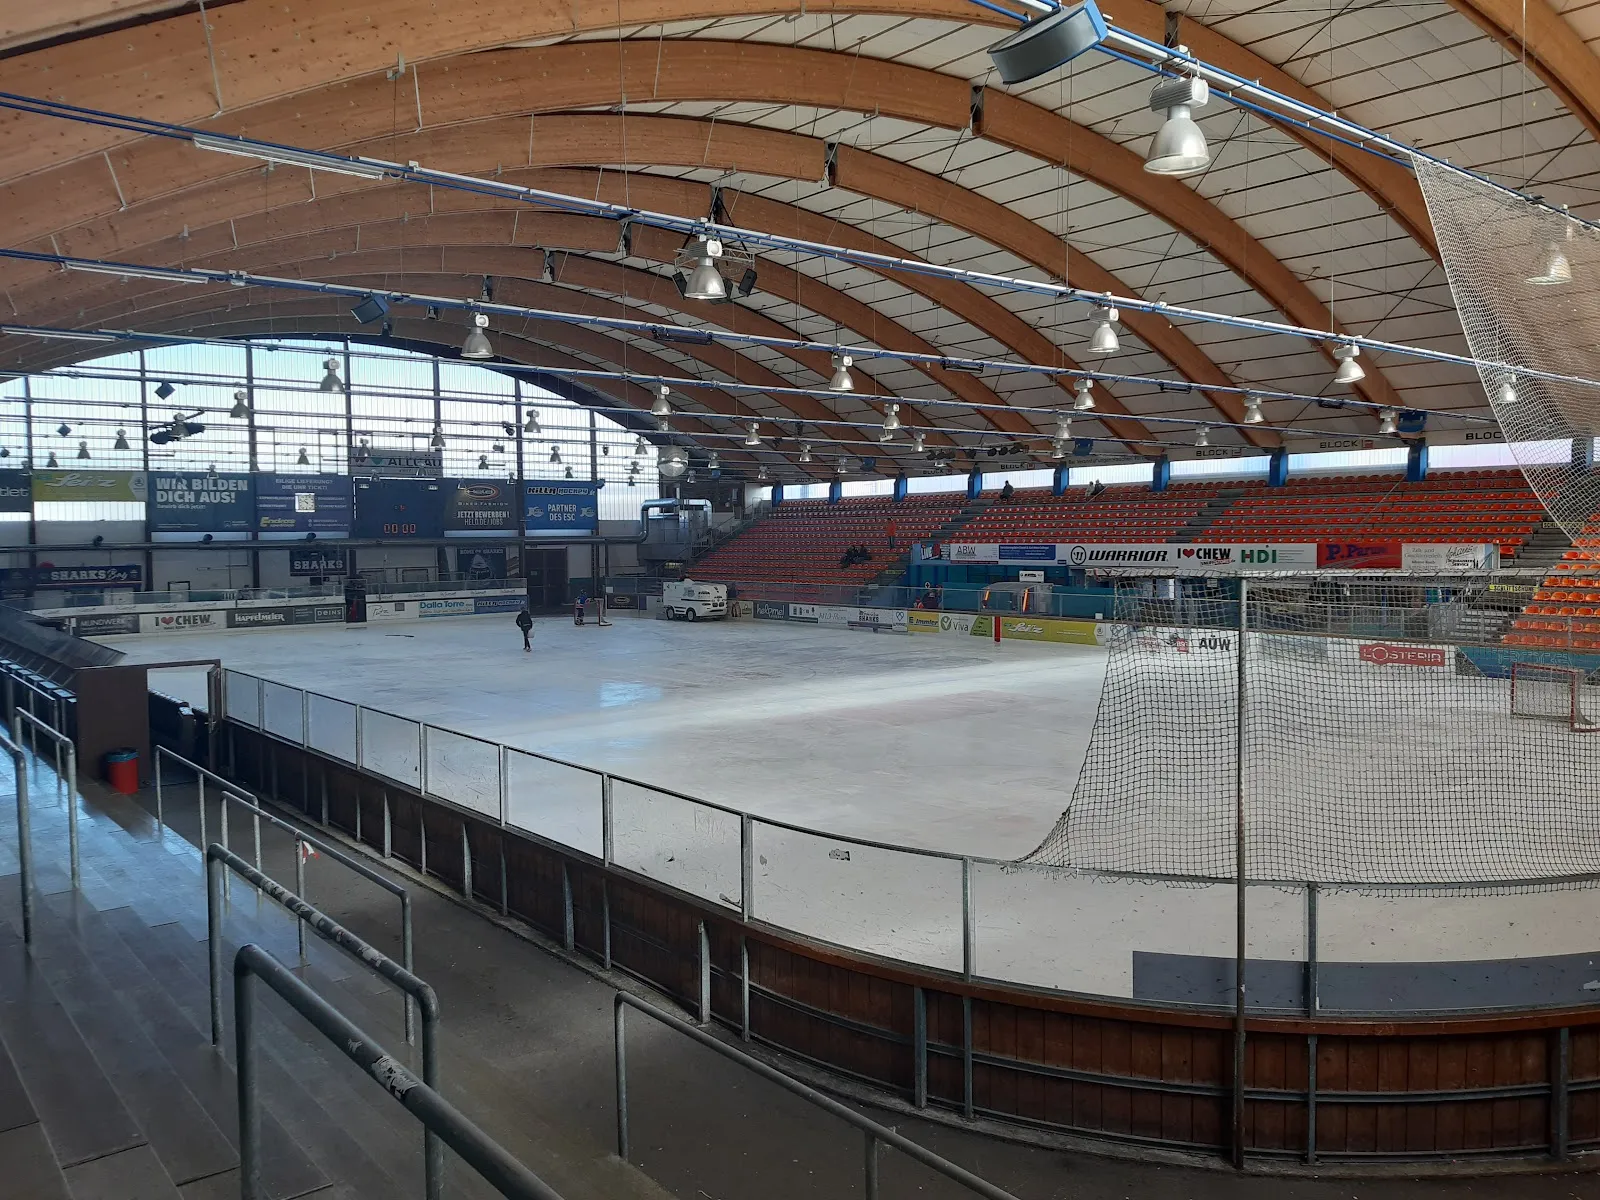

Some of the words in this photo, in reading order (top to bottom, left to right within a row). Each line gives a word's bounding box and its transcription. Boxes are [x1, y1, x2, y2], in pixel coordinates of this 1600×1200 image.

[1320, 440, 1358, 448] BLOCK
[156, 478, 188, 490] WIR
[192, 479, 248, 490] BILDEN
[156, 491, 195, 502] DICH
[199, 492, 236, 503] AUS!
[548, 504, 576, 512] PARTNER
[957, 546, 976, 554] ABW
[1178, 548, 1181, 558] I
[1196, 548, 1231, 559] CHEW
[1089, 550, 1167, 562] WARRIOR
[1241, 550, 1276, 563] HDI
[294, 560, 343, 569] SHARKS
[51, 570, 106, 580] SHARKS
[155, 617, 159, 626] I
[176, 614, 210, 626] CHEW
[953, 622, 968, 632] Viva
[1200, 635, 1230, 650] AÜW
